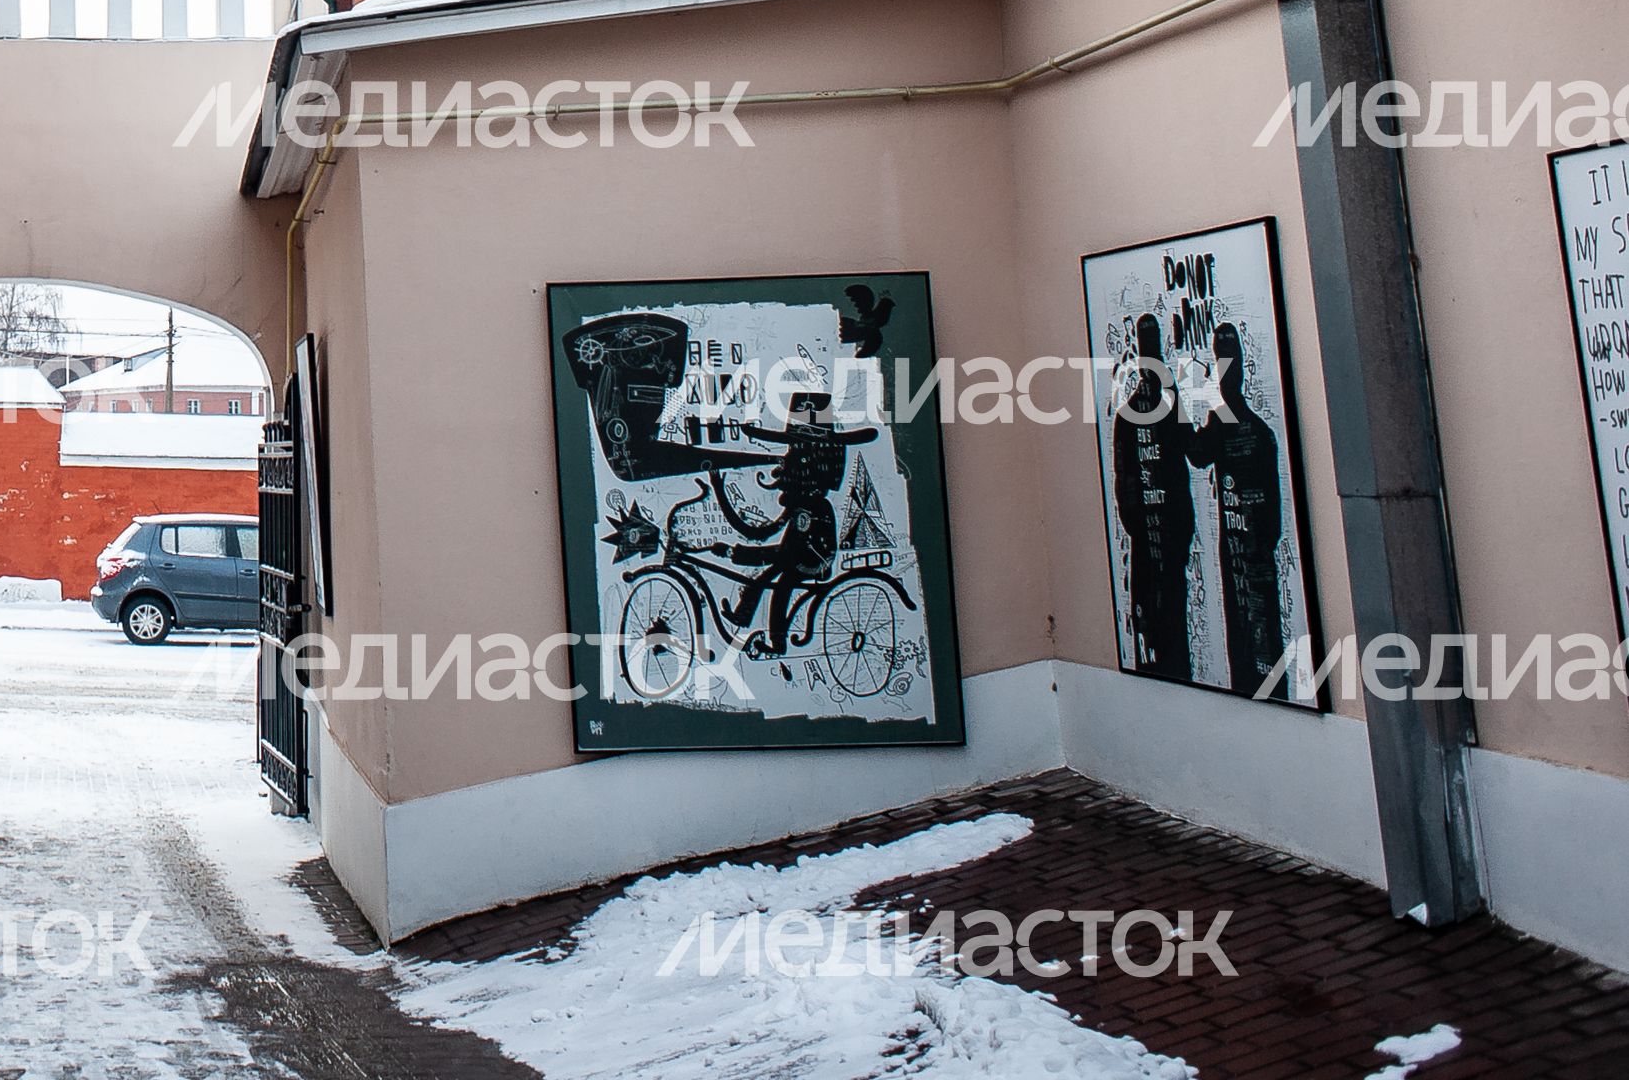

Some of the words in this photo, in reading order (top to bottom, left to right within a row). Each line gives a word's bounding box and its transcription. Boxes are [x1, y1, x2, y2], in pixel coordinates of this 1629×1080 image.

[1589, 164, 1611, 205] IT
[1575, 226, 1598, 270] MY
[1579, 274, 1625, 314] THAT
[1591, 366, 1626, 402] HOW
